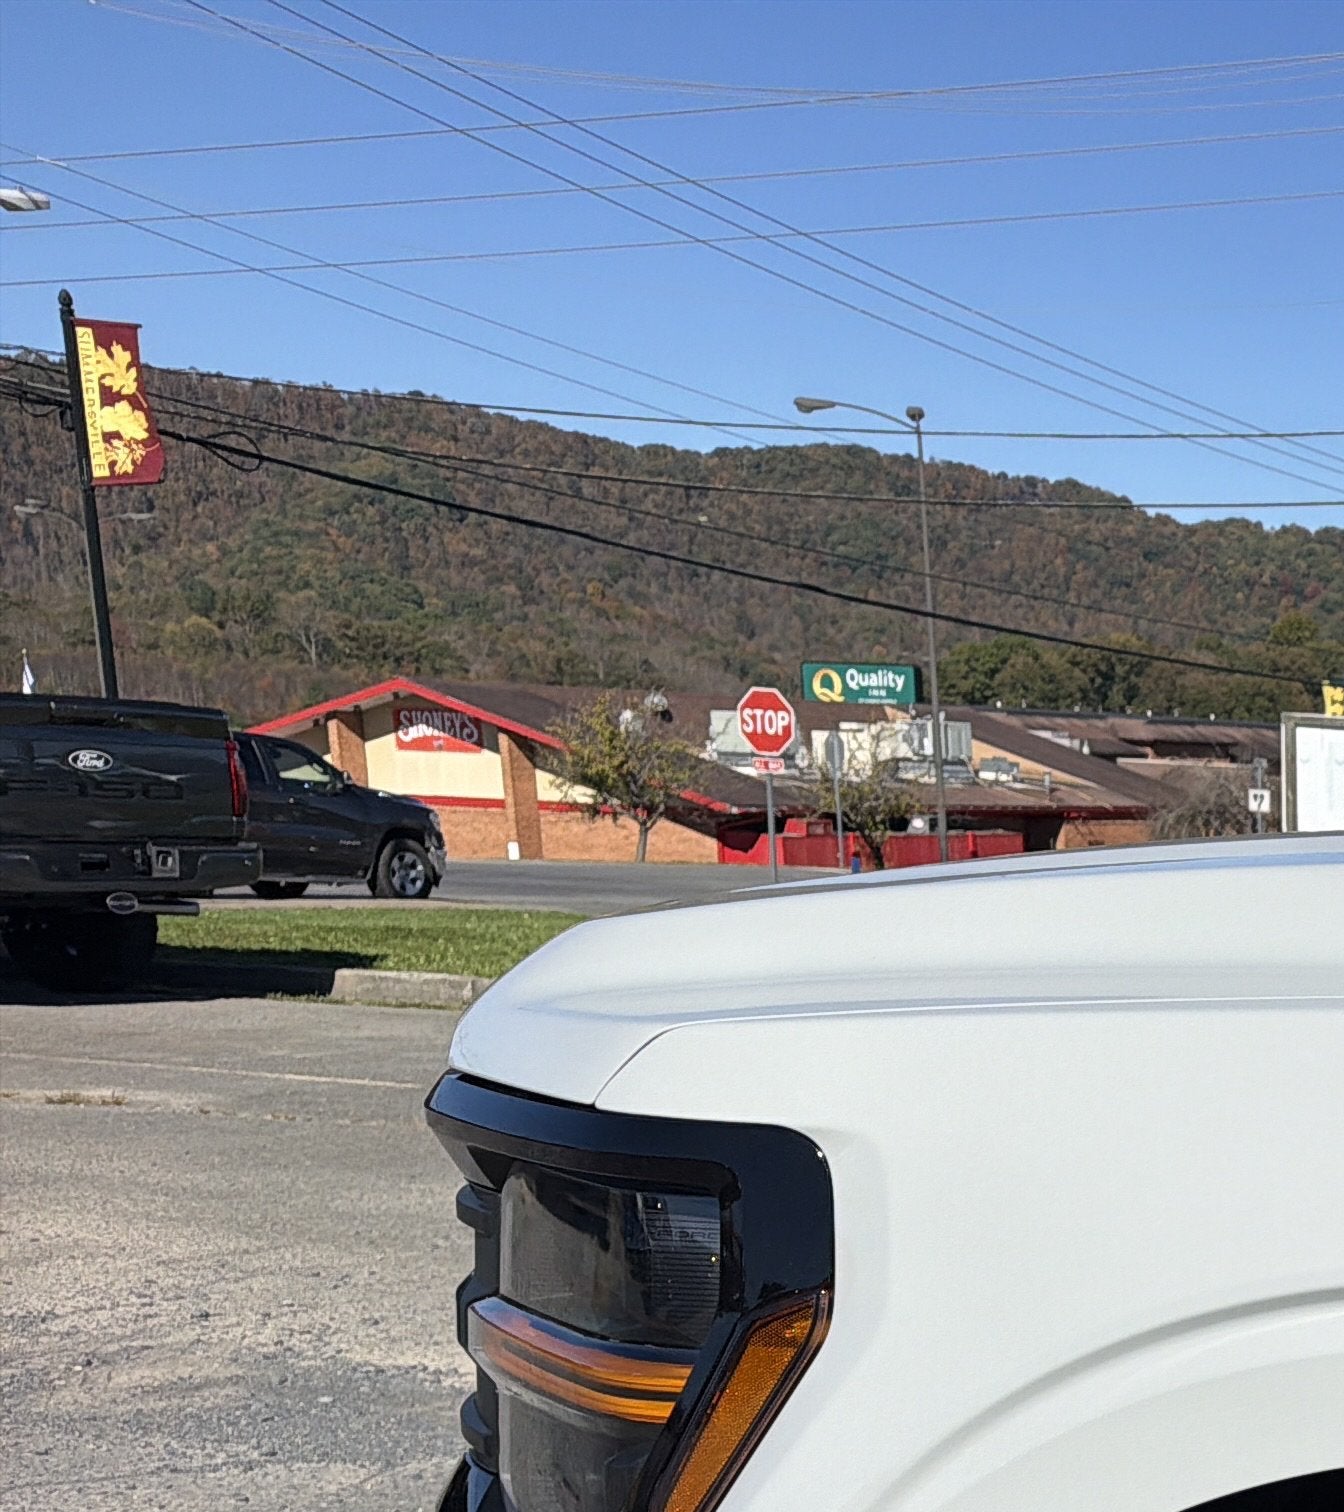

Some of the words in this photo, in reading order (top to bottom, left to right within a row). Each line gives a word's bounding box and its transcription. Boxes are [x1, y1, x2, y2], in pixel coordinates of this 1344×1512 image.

[845, 668, 906, 693] Quality
[742, 708, 790, 736] STOP
[76, 751, 106, 768] Ford
